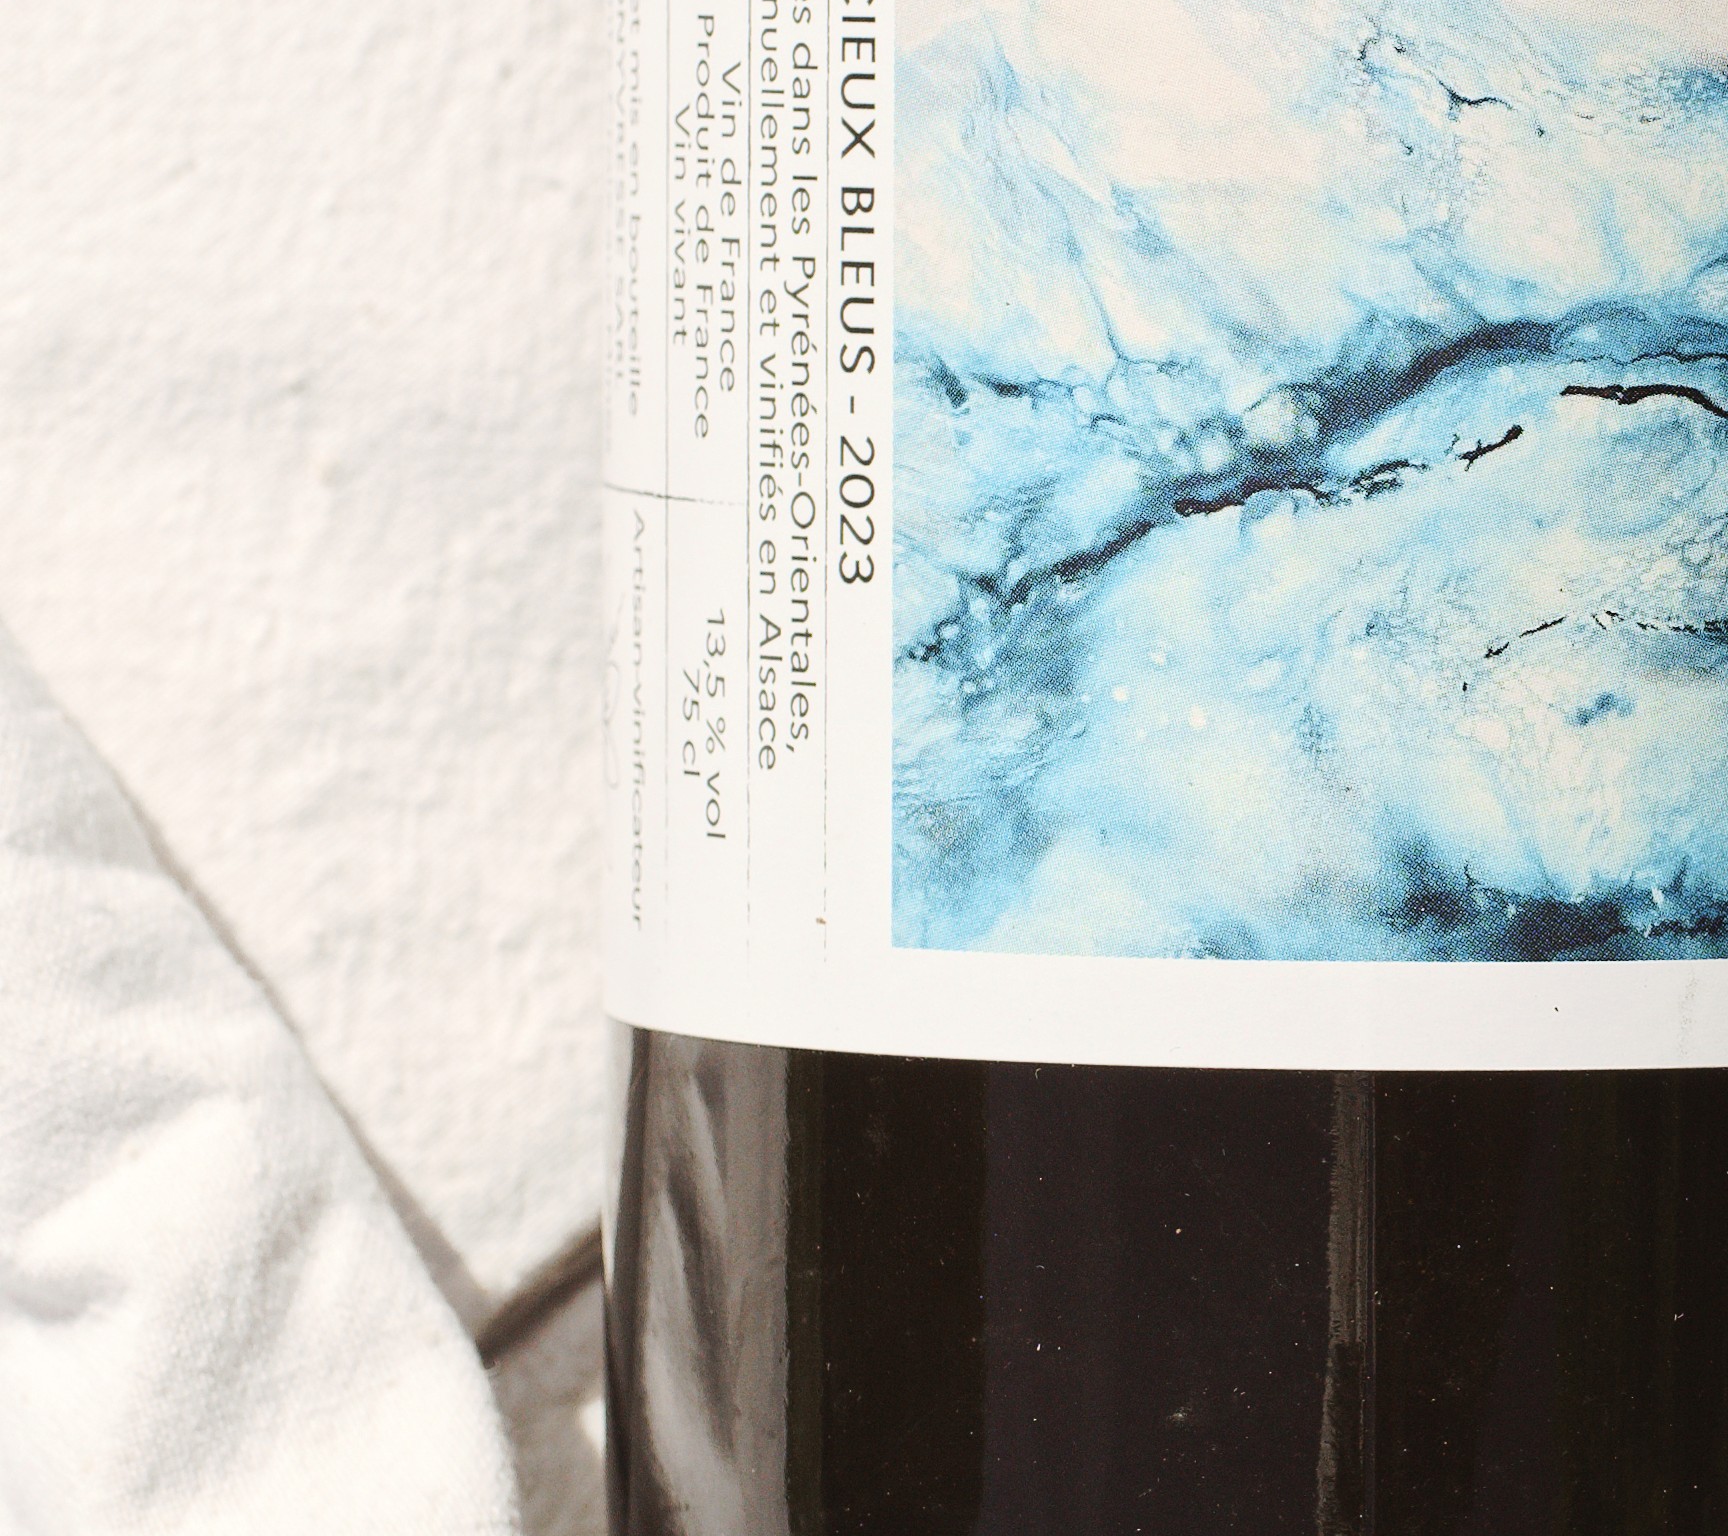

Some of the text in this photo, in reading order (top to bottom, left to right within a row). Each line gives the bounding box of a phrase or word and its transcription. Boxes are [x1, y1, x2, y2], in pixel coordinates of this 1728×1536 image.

[628, 49, 643, 128] mis
[628, 140, 640, 199] en
[791, 42, 819, 155] dans
[673, 103, 692, 345] Vin vivant
[694, 14, 716, 439] Produit de France
[719, 61, 743, 392] Vin de France
[791, 175, 818, 235] les
[839, 186, 876, 374] BLEUS
[627, 213, 641, 419] bouteille
[759, 288, 781, 337] et
[758, 352, 784, 522] vinifiés
[783, 255, 818, 753] Pyrénées-Orientales,
[838, 435, 876, 585] 2023
[758, 539, 777, 595] en
[631, 508, 646, 932] Artisan-vinificateur
[682, 669, 701, 777] 75 cl
[702, 608, 727, 840] 13,5 % vol
[758, 613, 784, 770] Alsace
